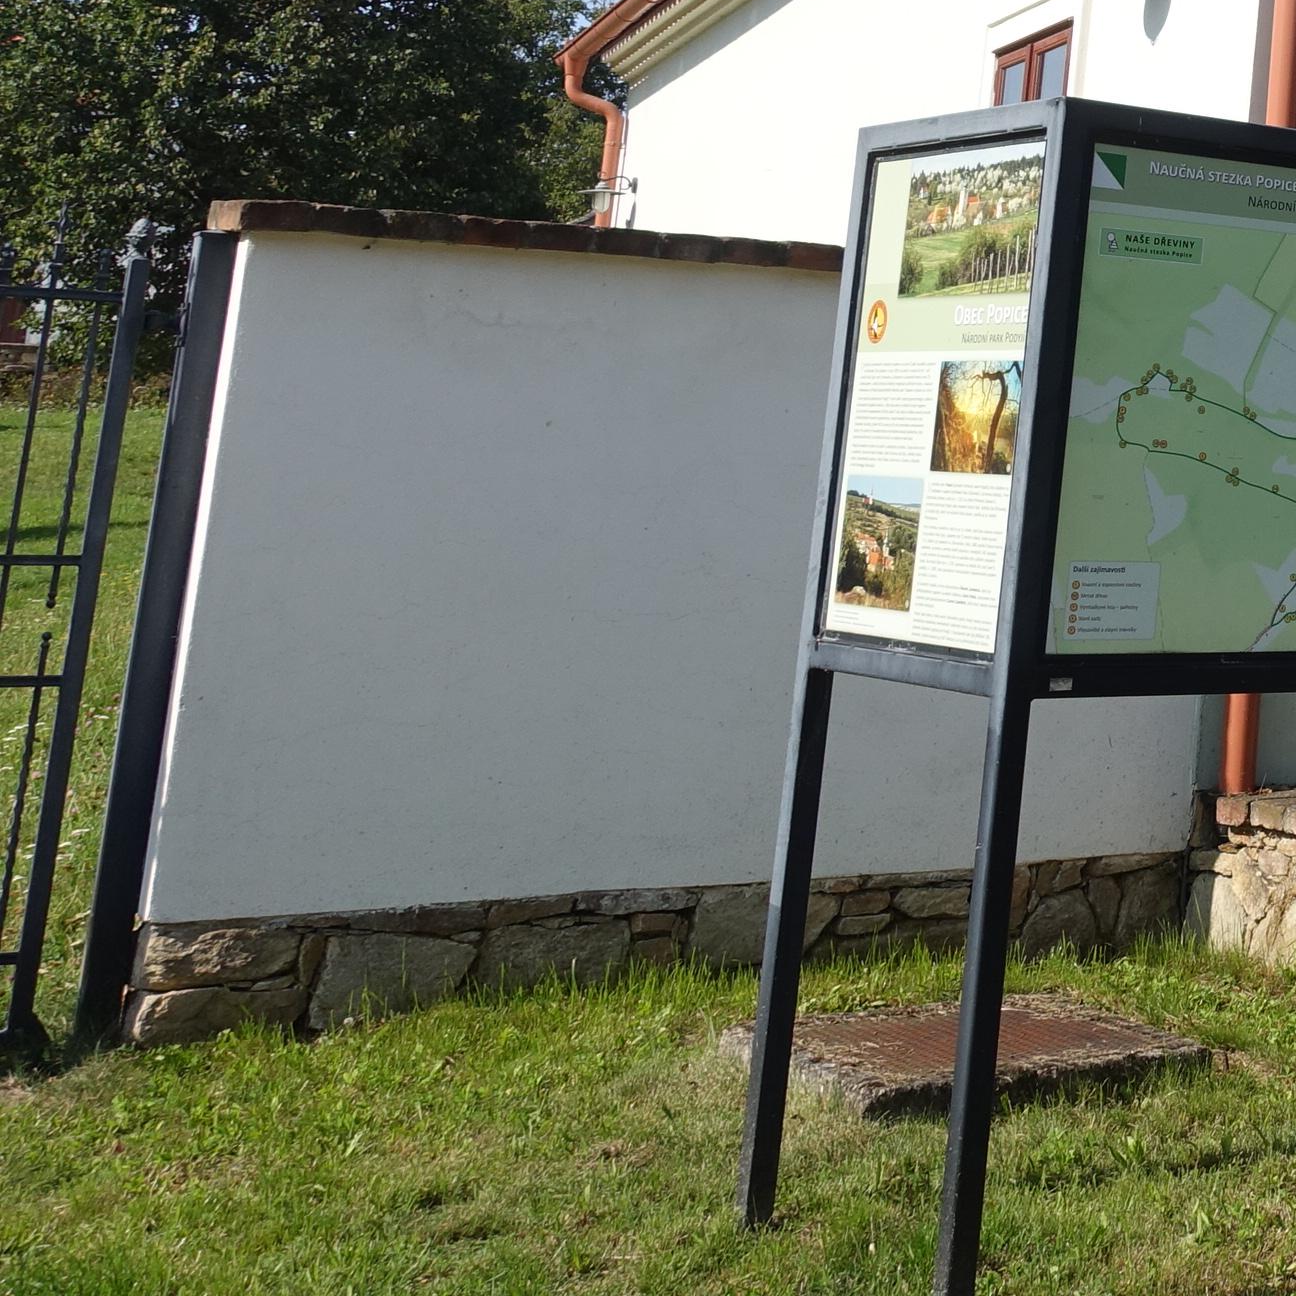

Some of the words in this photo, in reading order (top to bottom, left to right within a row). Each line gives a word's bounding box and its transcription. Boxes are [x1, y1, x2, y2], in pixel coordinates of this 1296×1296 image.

[1149, 160, 1205, 181] NAUČNÁ
[1207, 171, 1253, 187] STEZKA
[1248, 195, 1296, 213] NÁRODNÍ
[1125, 233, 1151, 245] NAŠE
[1154, 236, 1195, 249] DŘEVINY
[954, 304, 984, 325] OBEC
[986, 304, 1029, 324] POPICE
